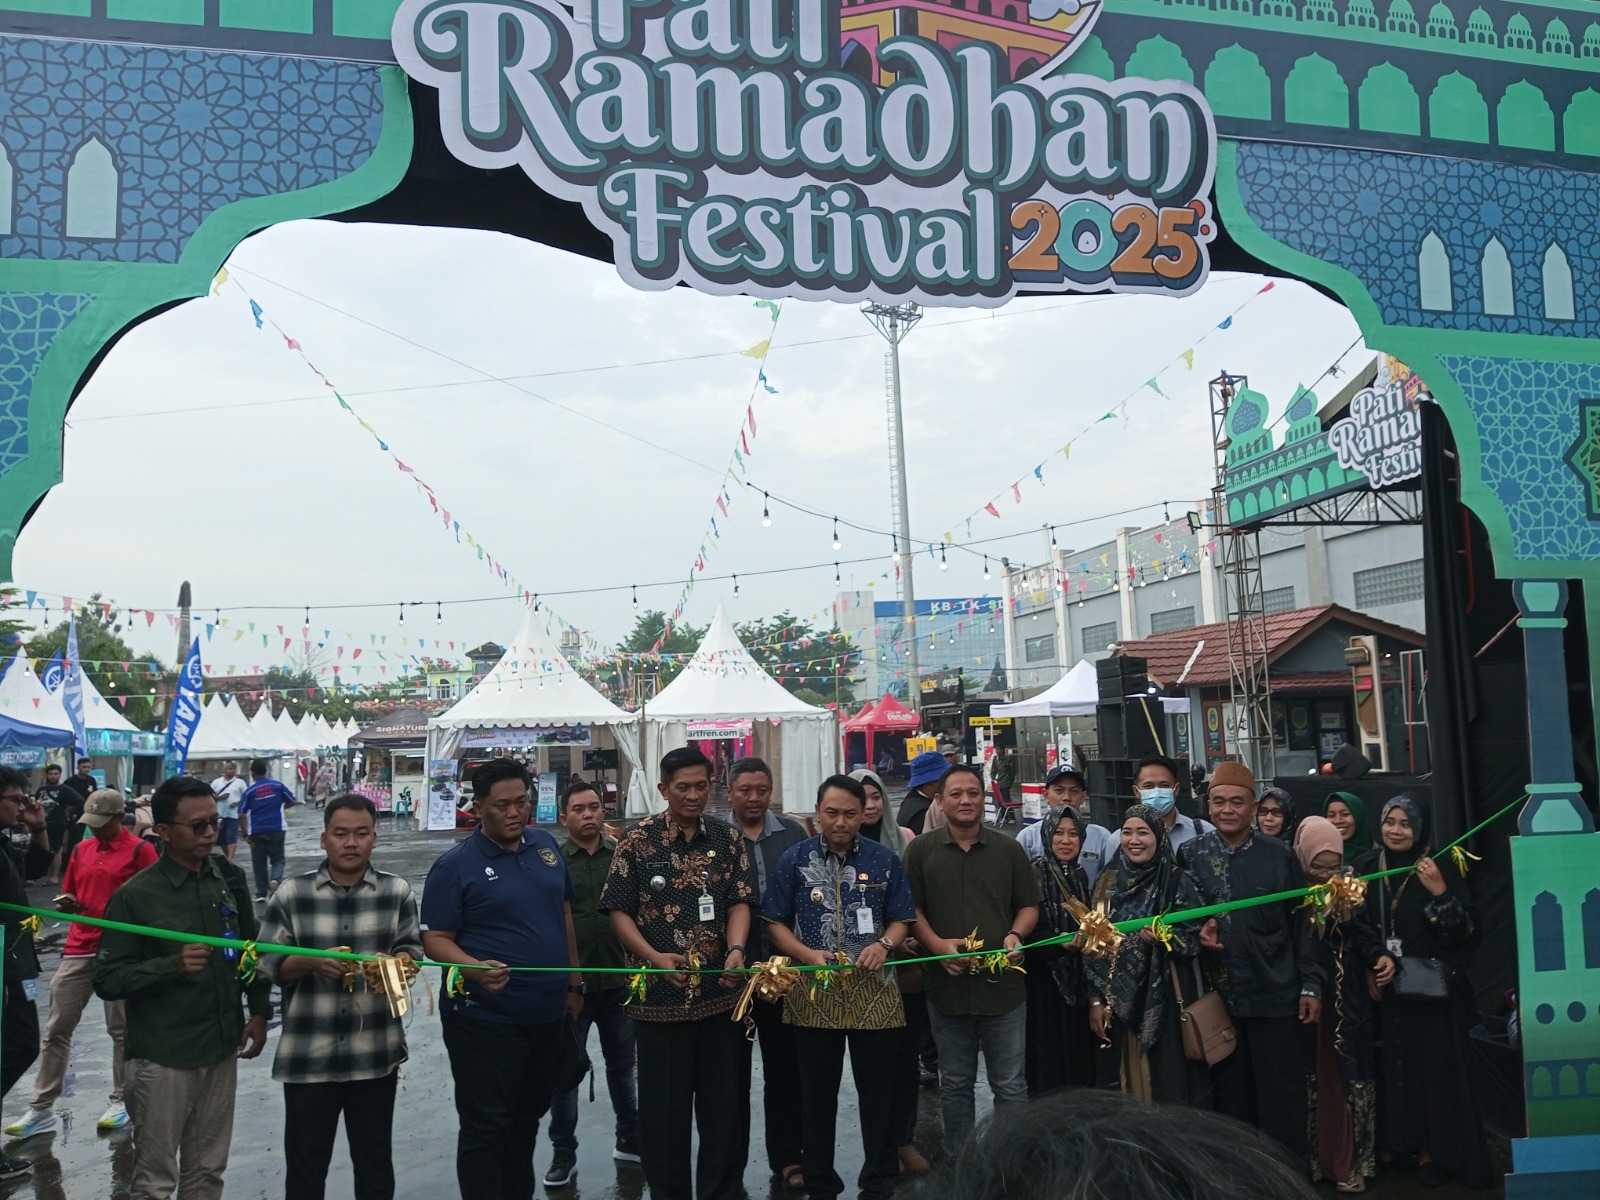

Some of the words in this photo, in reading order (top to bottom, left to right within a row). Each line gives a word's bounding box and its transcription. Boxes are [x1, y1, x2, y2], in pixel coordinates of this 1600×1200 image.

[417, 0, 1200, 196] Ramadhan
[604, 165, 998, 282] Festival
[1010, 198, 1200, 280] 2025
[1353, 381, 1404, 426] Pati
[687, 730, 738, 738] artfren.com
